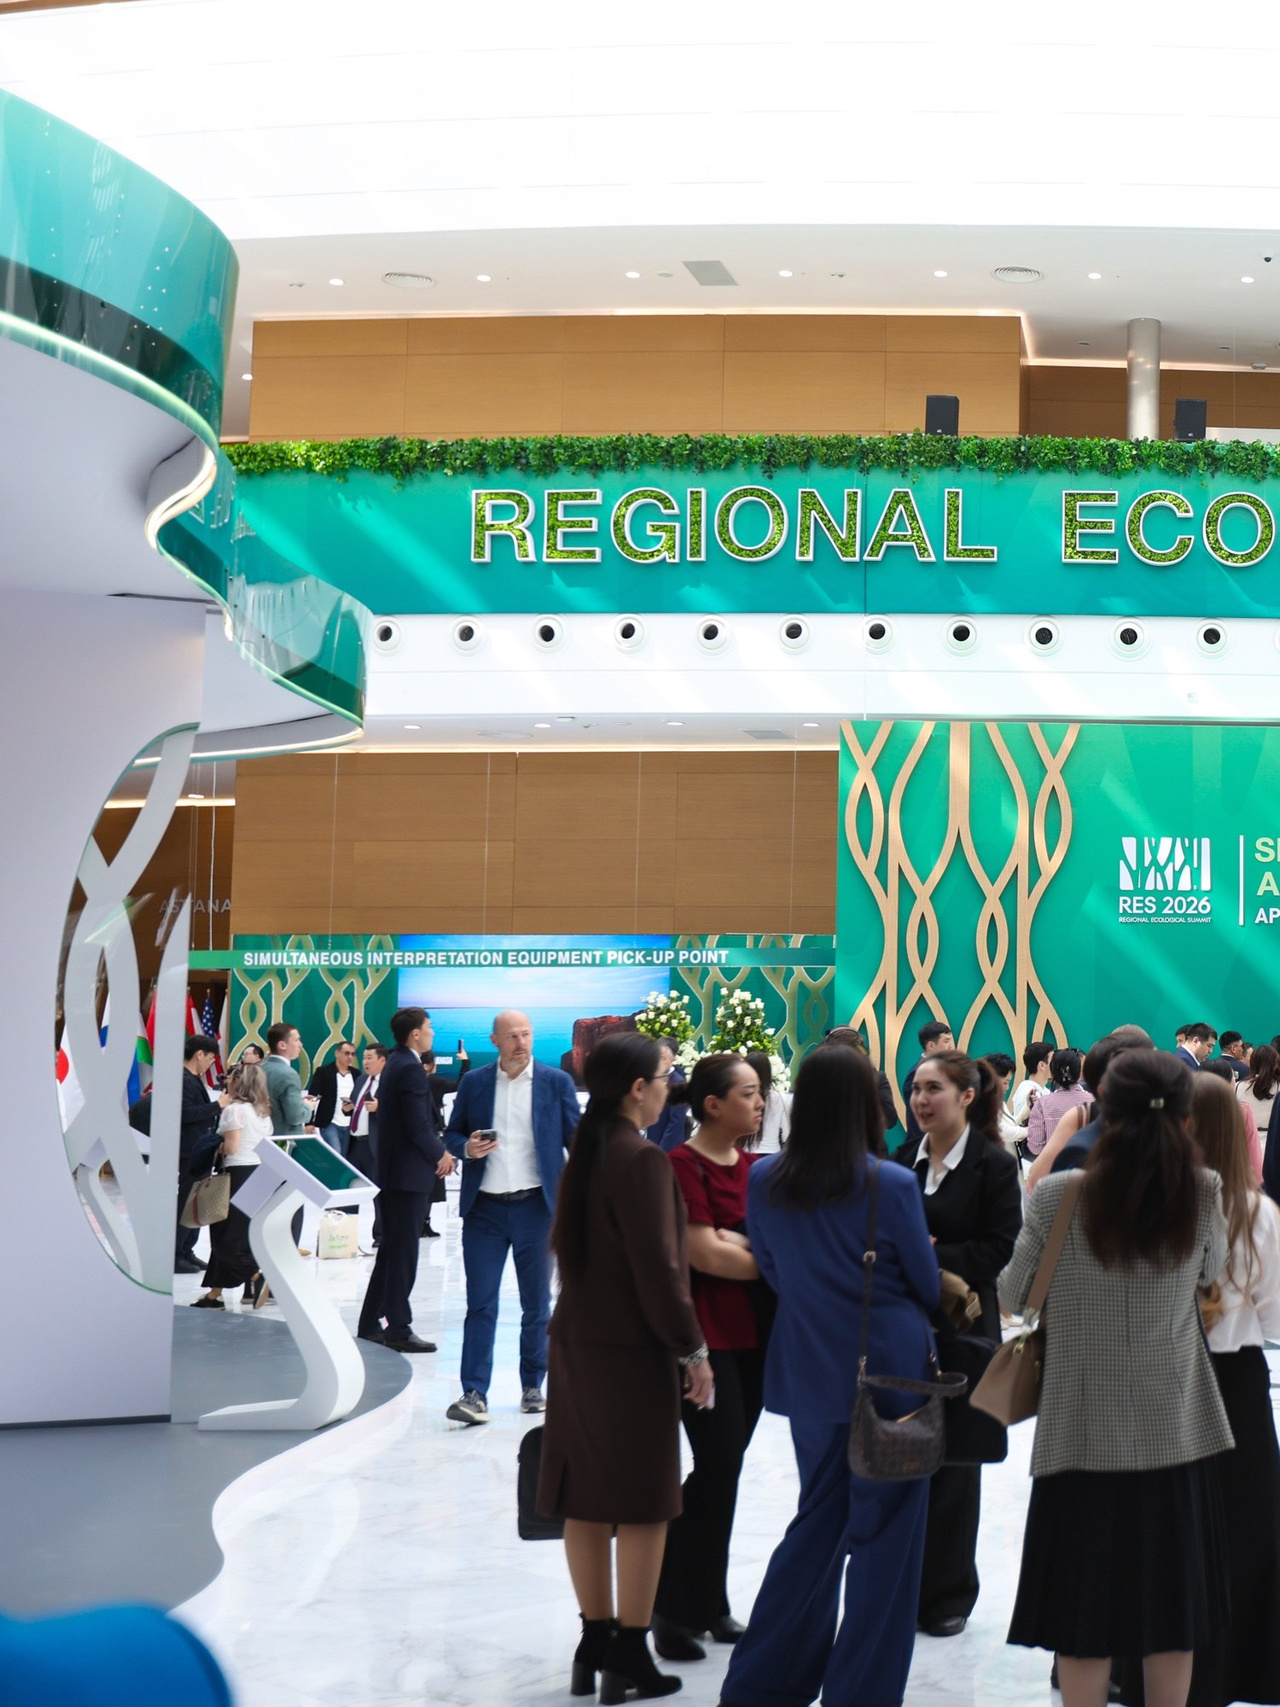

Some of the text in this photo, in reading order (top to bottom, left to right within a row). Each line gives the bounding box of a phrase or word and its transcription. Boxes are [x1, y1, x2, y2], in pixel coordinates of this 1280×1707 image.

[471, 486, 997, 563] REGIONAL
[1256, 871, 1280, 897] A
[1119, 896, 1211, 915] RES 2026
[243, 950, 729, 966] SIMULTANEOUS INTERPRETATION EQUIPMENT PICK-UP POINT
